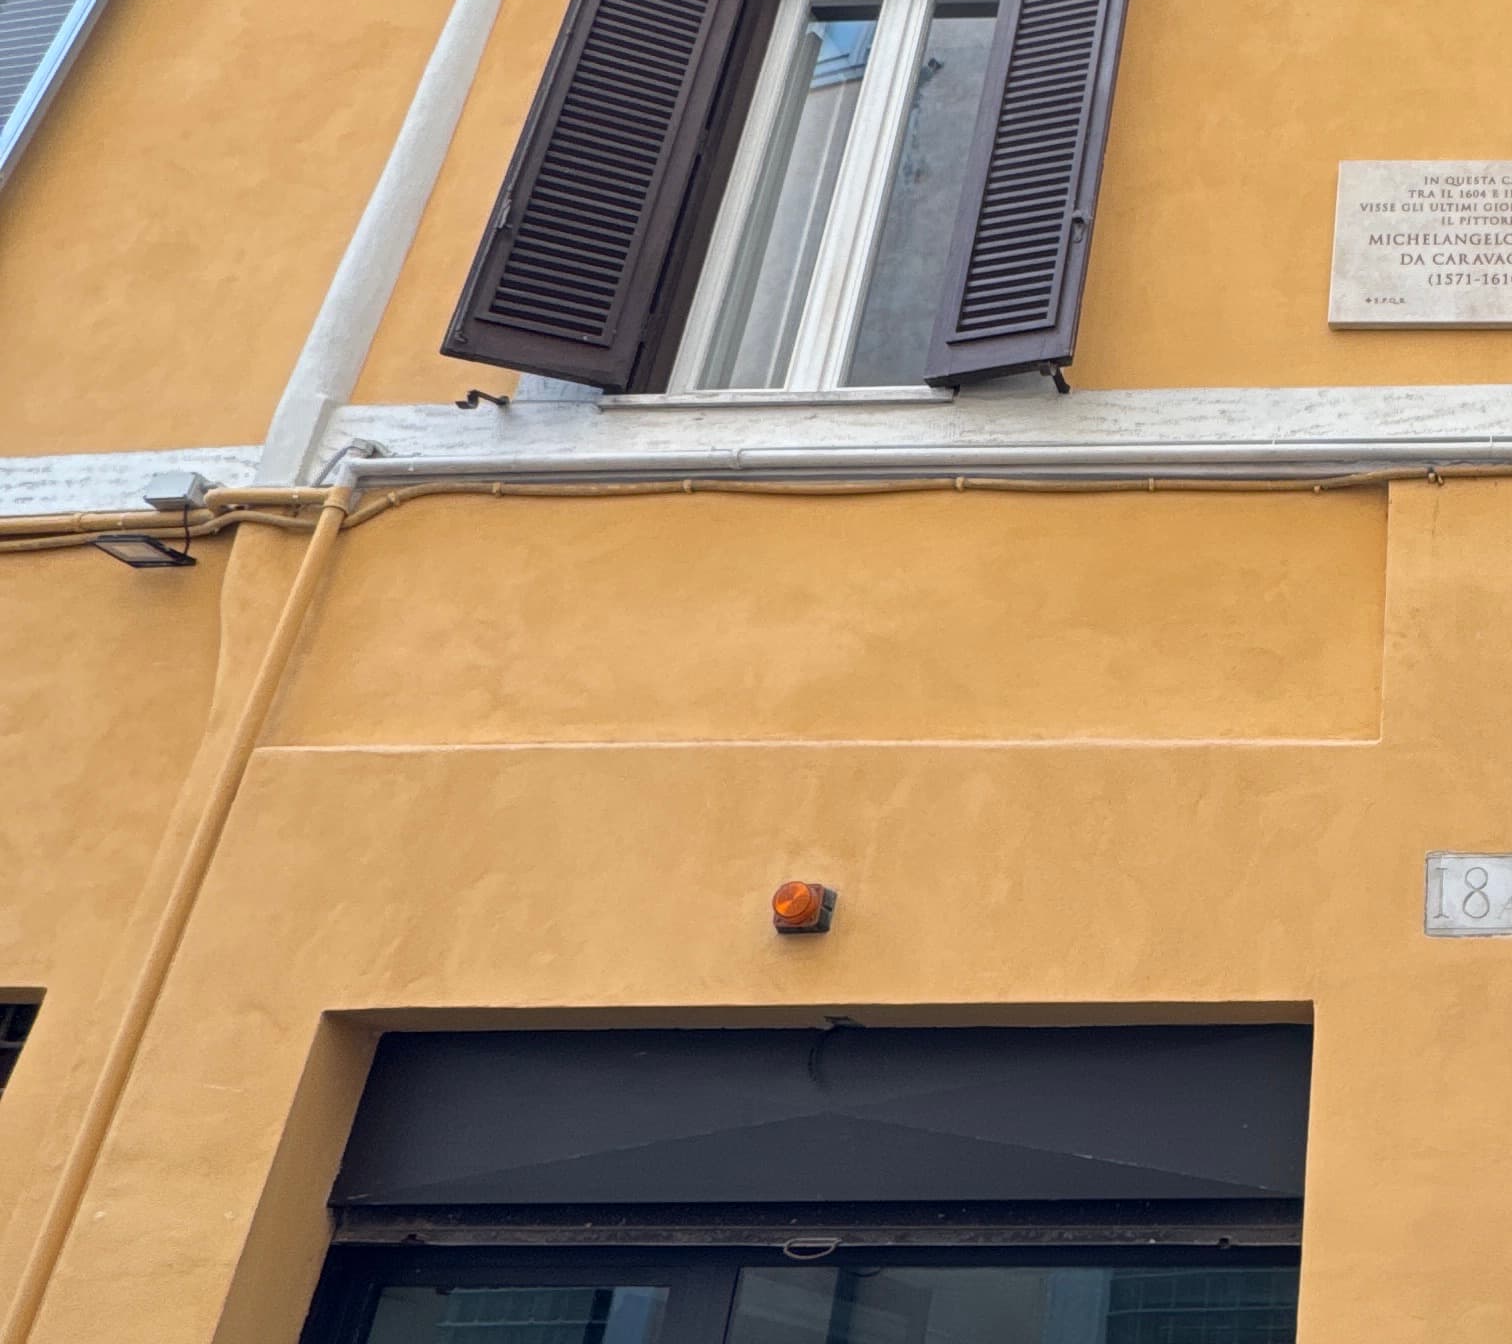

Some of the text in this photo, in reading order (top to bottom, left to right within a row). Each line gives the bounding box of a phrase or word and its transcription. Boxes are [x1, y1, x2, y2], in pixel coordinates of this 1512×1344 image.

[1424, 176, 1440, 185] IN
[1445, 176, 1497, 187] QUESTA
[1408, 189, 1436, 199] TRA
[1441, 189, 1454, 199] IL
[1460, 189, 1487, 199] 1604
[1492, 189, 1499, 199] E
[1360, 202, 1396, 213] VISSE
[1401, 202, 1424, 213] GLI
[1429, 202, 1478, 213] ULTIMI
[1441, 216, 1455, 226] IL
[1400, 253, 1426, 266] DA
